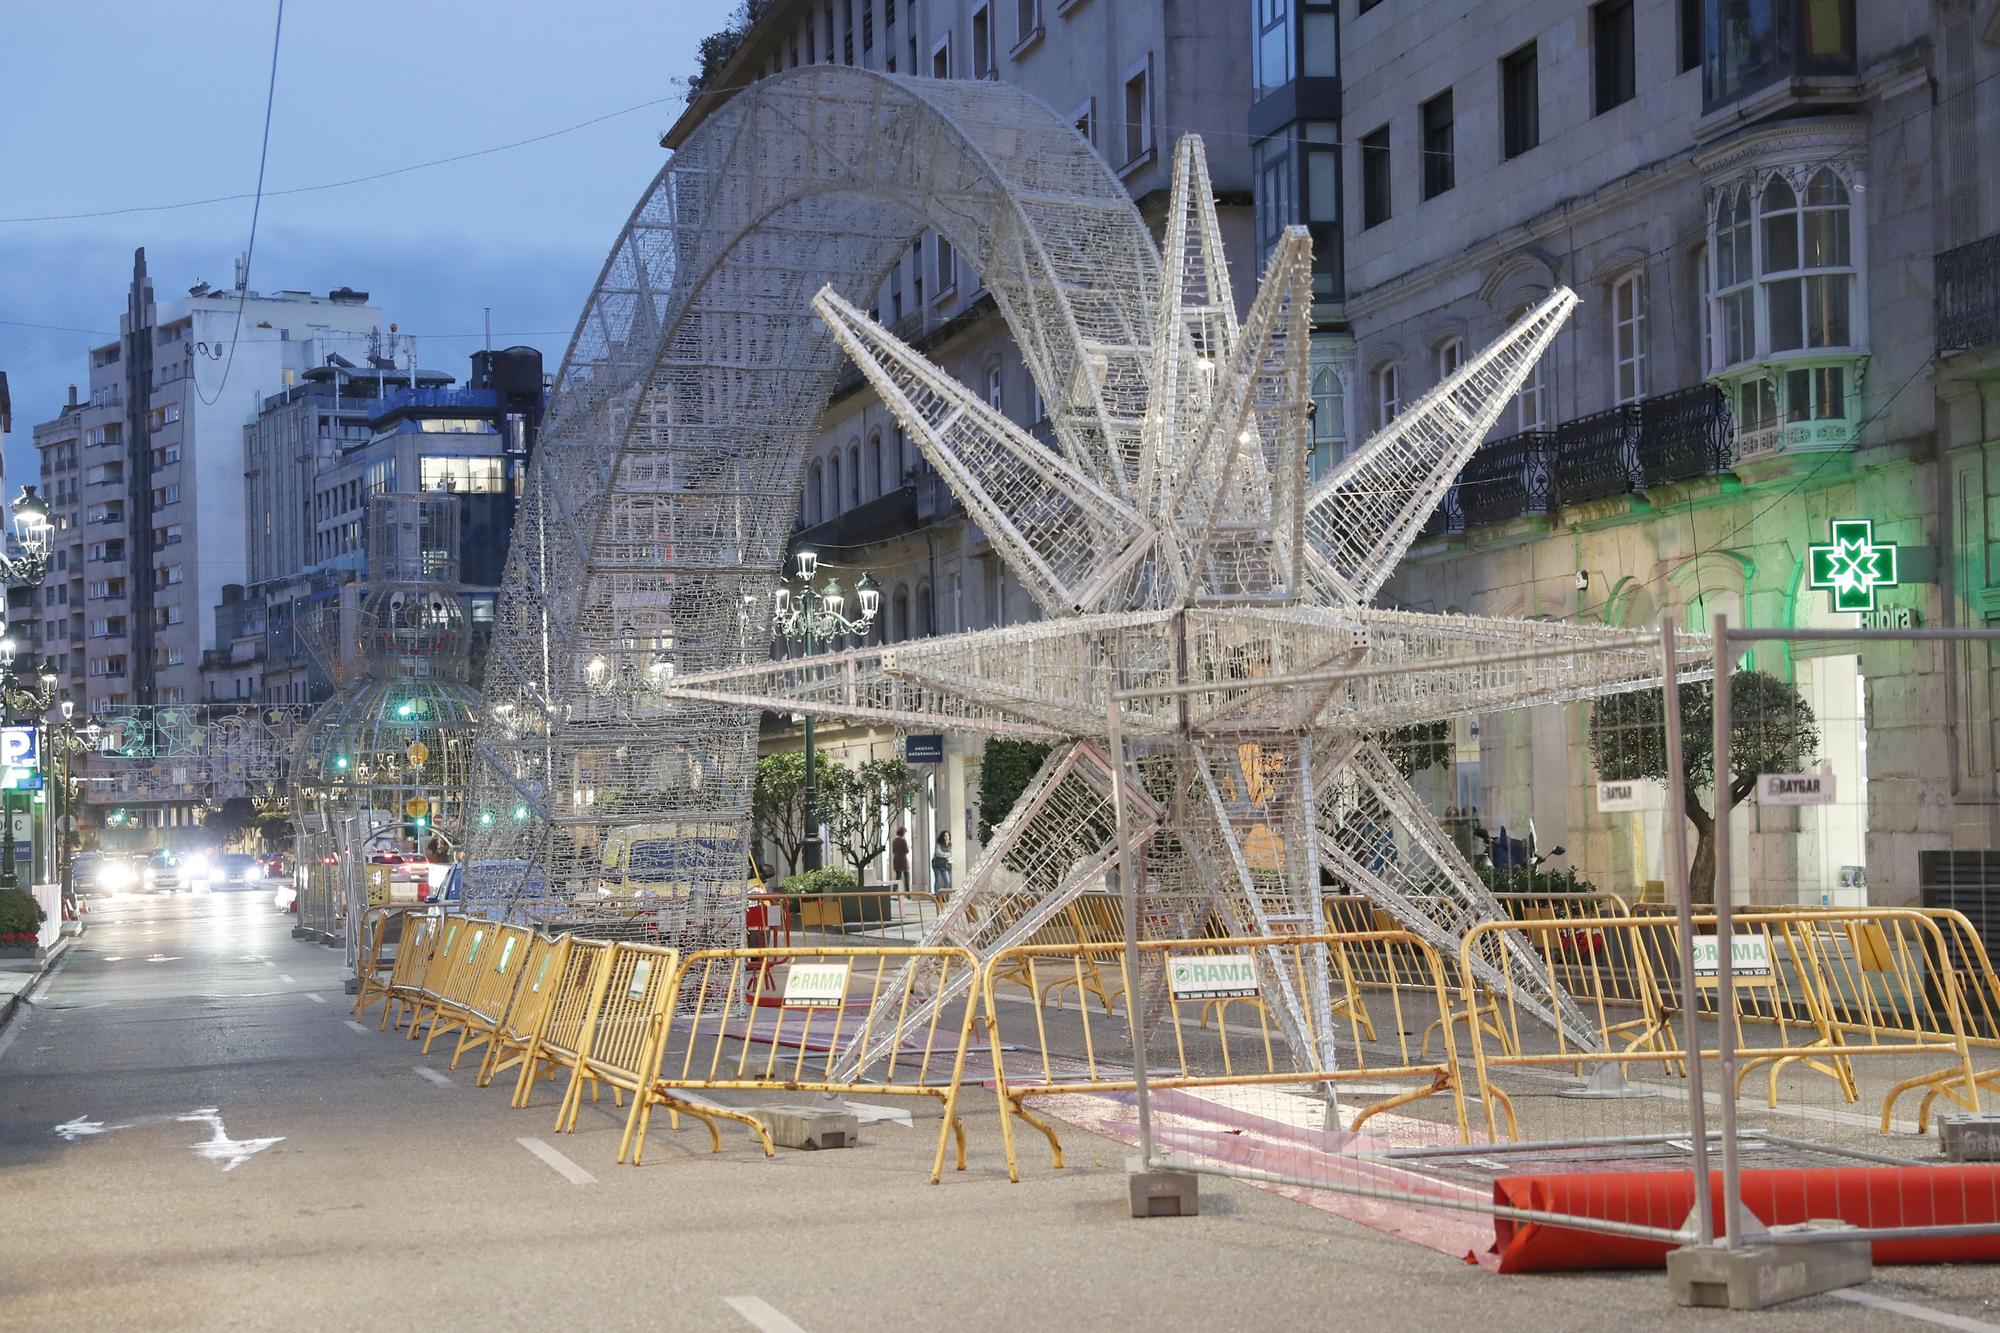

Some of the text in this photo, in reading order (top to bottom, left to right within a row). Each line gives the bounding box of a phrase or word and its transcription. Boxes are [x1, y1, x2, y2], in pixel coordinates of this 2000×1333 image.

[1860, 602, 1911, 630] Rubira
[1, 731, 31, 767] P
[1705, 944, 1766, 960] RMA
[801, 973, 843, 990] RAMA
[1193, 964, 1254, 982] RAMA
